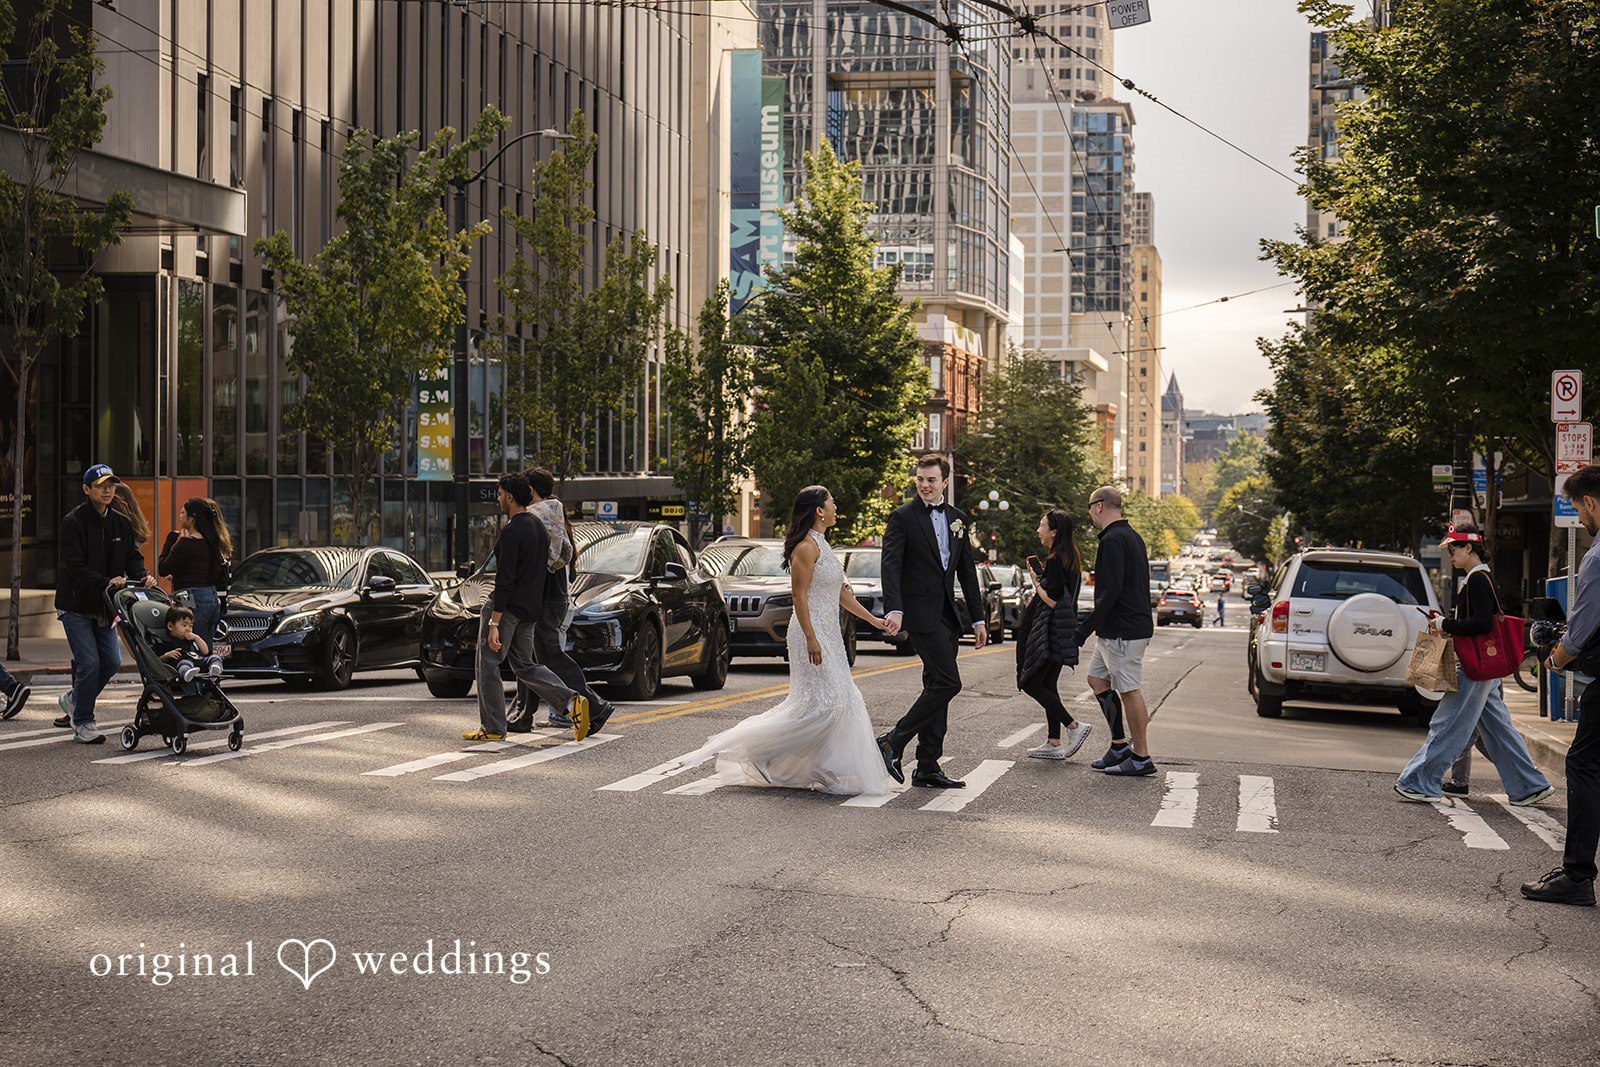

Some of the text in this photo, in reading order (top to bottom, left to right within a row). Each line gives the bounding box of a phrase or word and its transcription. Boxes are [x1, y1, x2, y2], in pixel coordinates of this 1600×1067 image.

[1111, 1, 1144, 15] POWER
[1121, 14, 1137, 25] OFF
[761, 105, 779, 226] Museum
[419, 390, 449, 403] SAM
[420, 413, 449, 426] SAM
[420, 436, 449, 448] SAM
[1562, 434, 1587, 442] STOPS
[421, 458, 449, 471] SAM
[1353, 627, 1393, 637] RAV4
